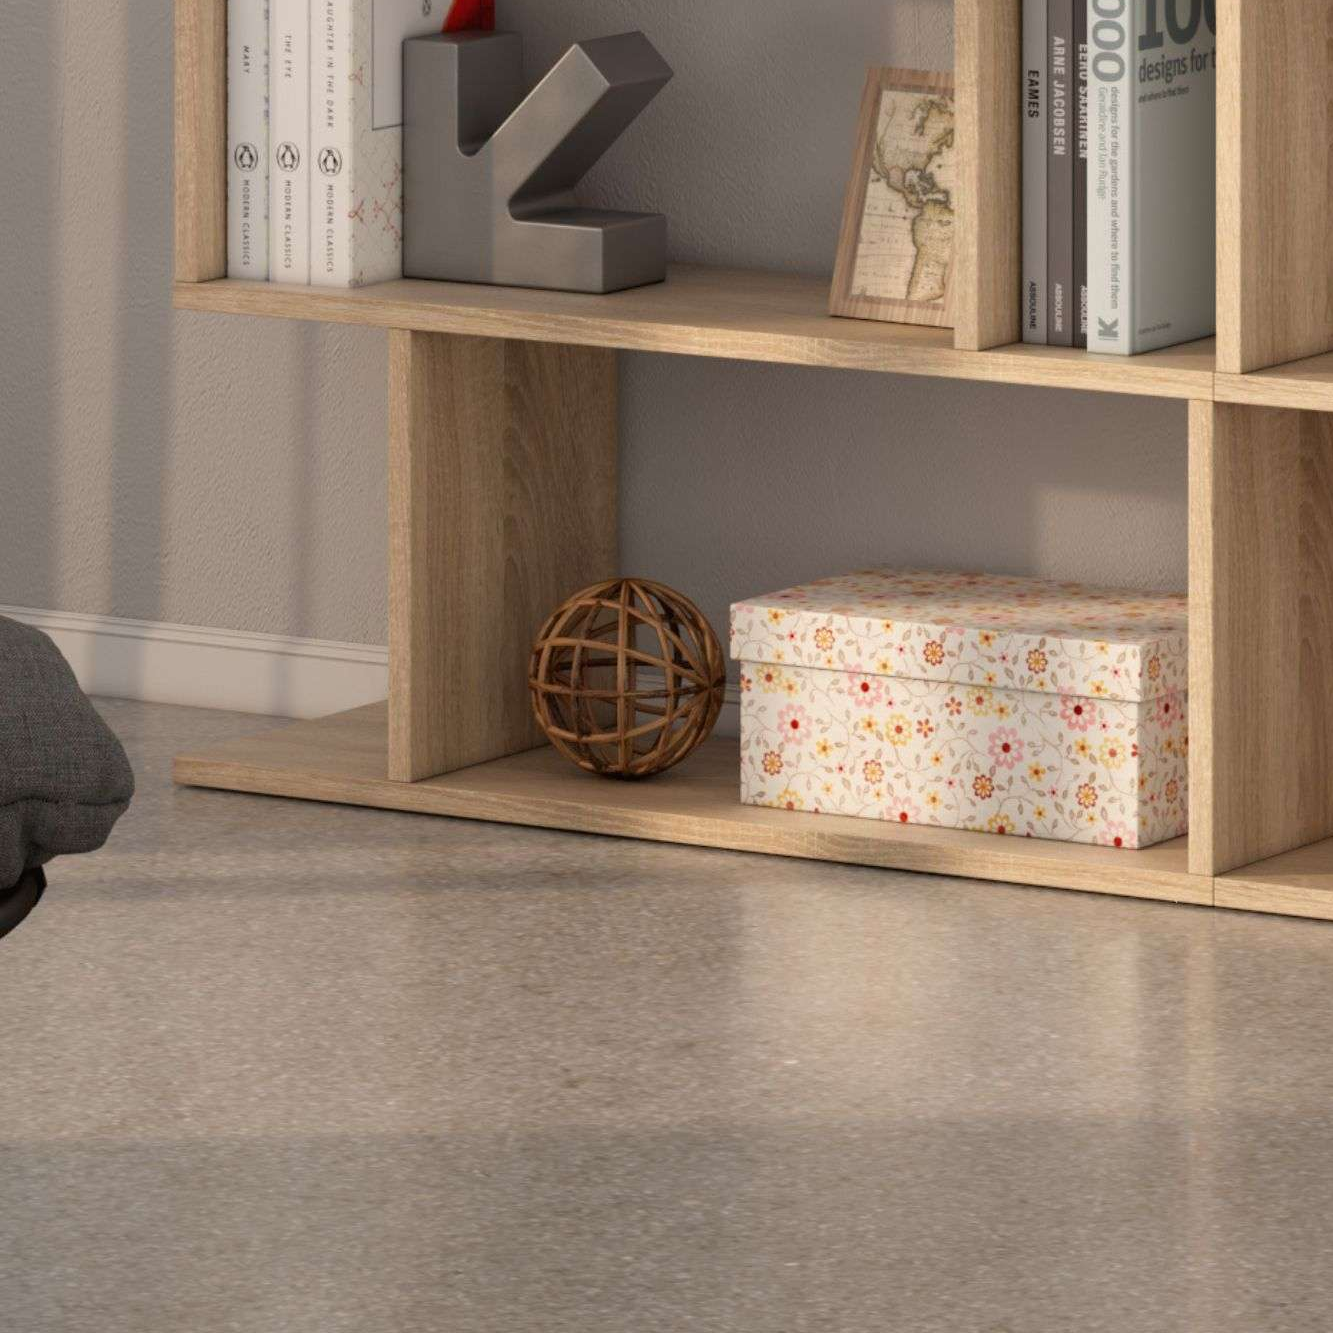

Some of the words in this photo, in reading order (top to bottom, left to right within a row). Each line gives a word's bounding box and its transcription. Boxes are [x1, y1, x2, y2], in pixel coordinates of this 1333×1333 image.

[1053, 36, 1066, 75] ARNE
[1138, 53, 1188, 84] designs
[1190, 47, 1208, 73] for
[1028, 69, 1040, 119] EAMES
[1110, 86, 1120, 123] designs
[1053, 80, 1066, 156] JACOBSEN
[1110, 141, 1119, 157] the
[1109, 159, 1120, 197] gardens
[1110, 199, 1120, 218] and
[1110, 220, 1120, 250] where
[1110, 263, 1120, 283] find
[1110, 284, 1120, 310] them
